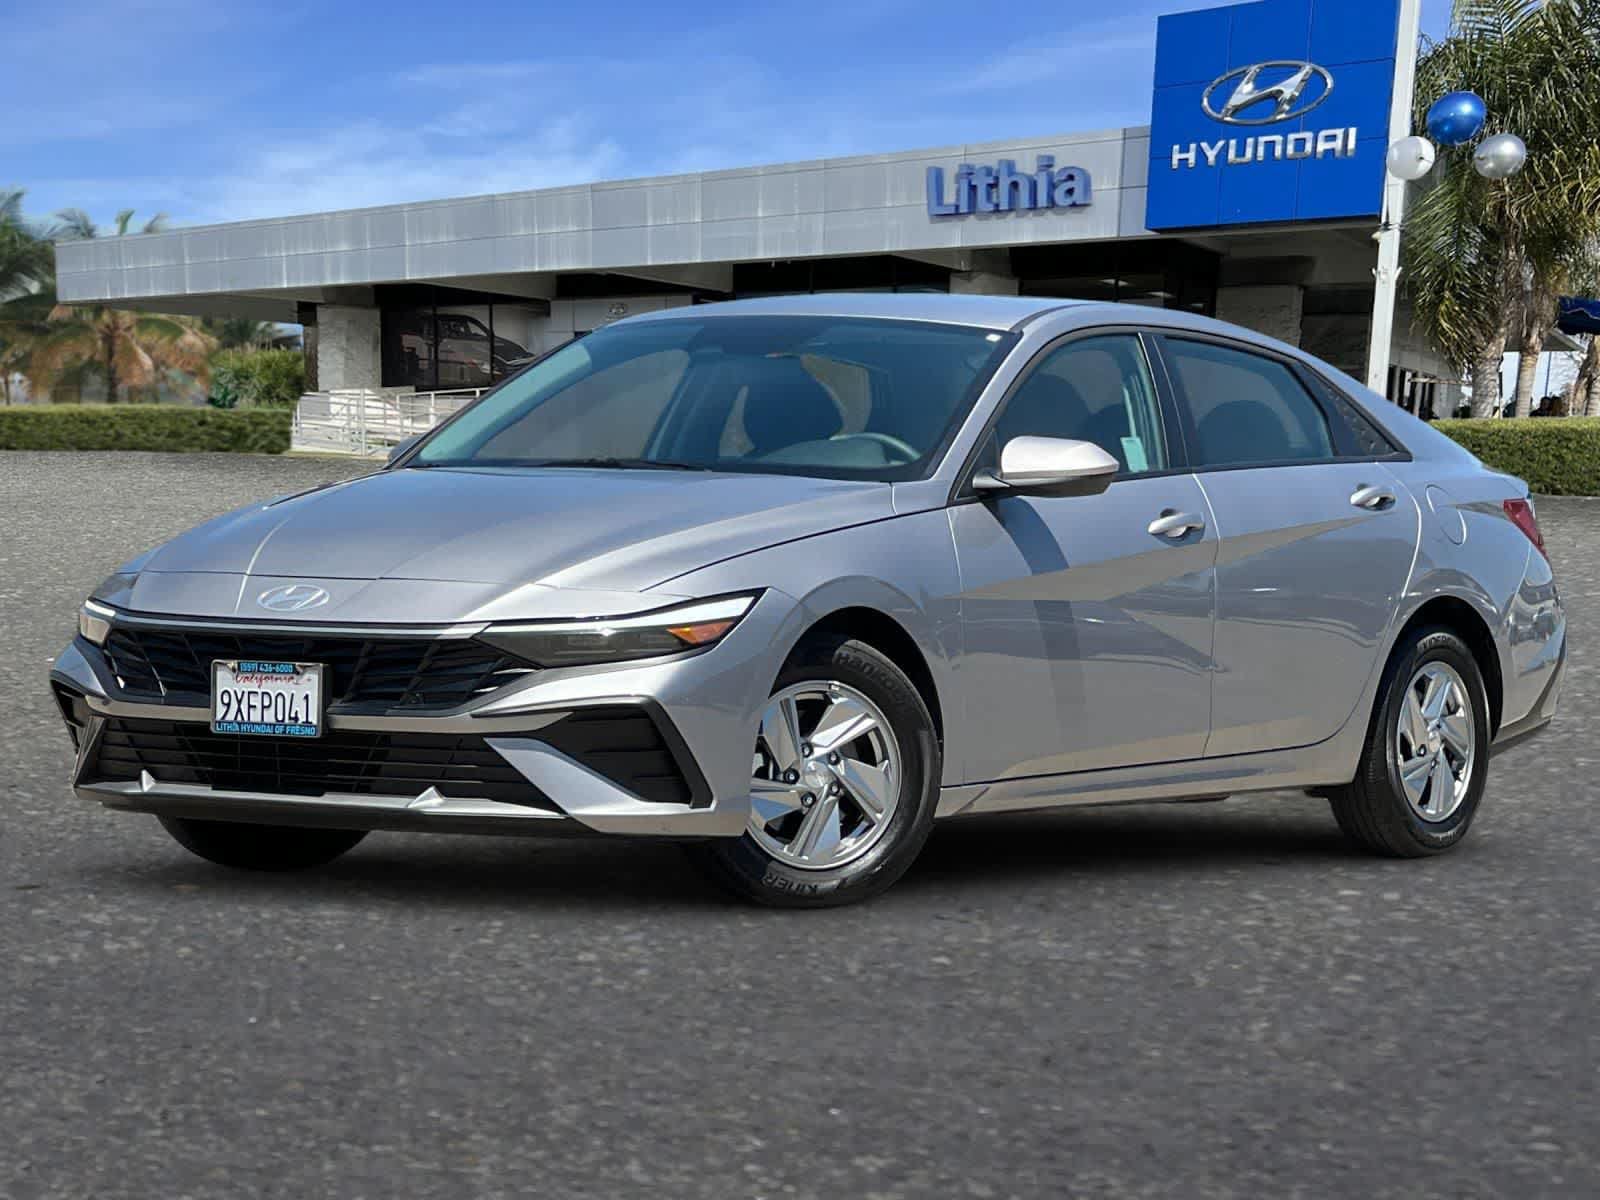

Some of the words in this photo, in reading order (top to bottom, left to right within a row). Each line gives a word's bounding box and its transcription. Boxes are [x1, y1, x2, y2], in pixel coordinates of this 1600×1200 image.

[1170, 127, 1359, 170] HYUNDAI
[926, 154, 1093, 217] Lithia
[220, 689, 313, 725] 9XFP041
[215, 722, 239, 732] LITHIA
[240, 723, 274, 734] HYUNDAI
[274, 726, 286, 735] OF
[286, 726, 316, 736] FRESNO
